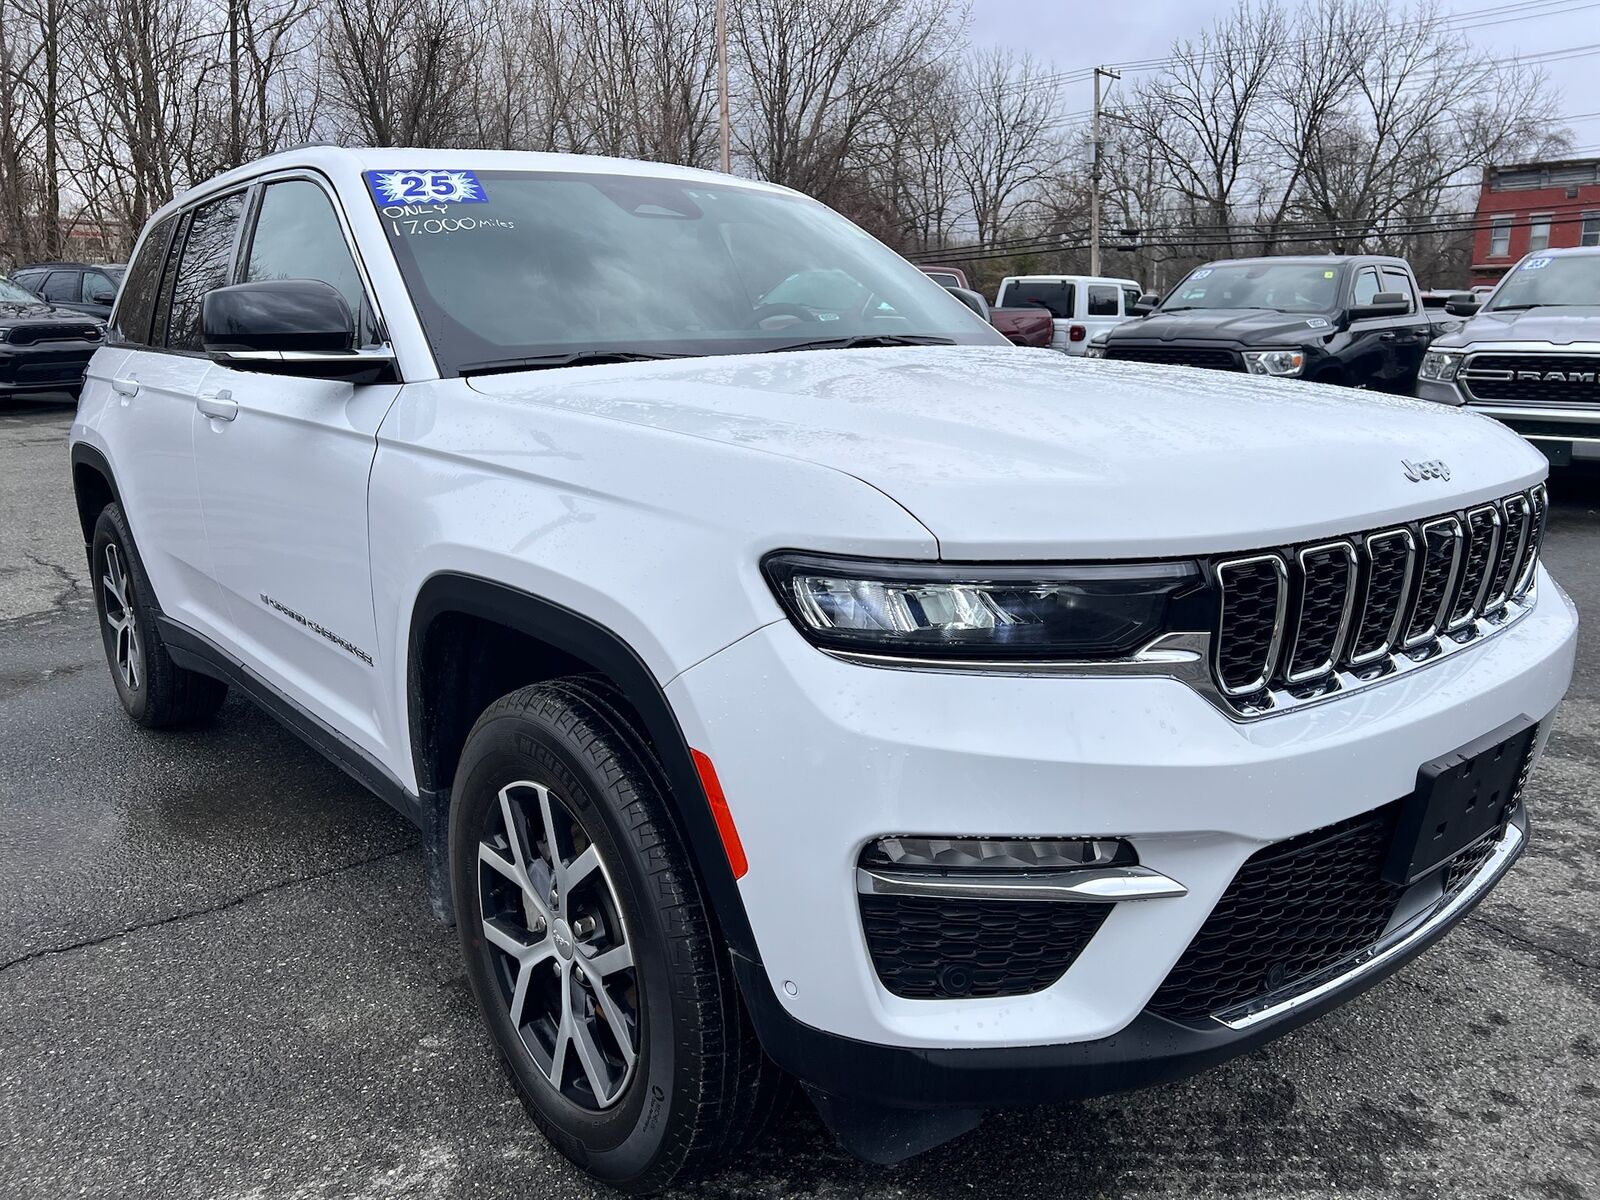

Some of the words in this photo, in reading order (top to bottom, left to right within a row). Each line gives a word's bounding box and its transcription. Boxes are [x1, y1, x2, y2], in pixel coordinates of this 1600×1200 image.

[400, 175, 457, 198] 25
[382, 203, 449, 219] ONLY
[1517, 370, 1596, 383] RAM
[1400, 459, 1451, 483] Jeep
